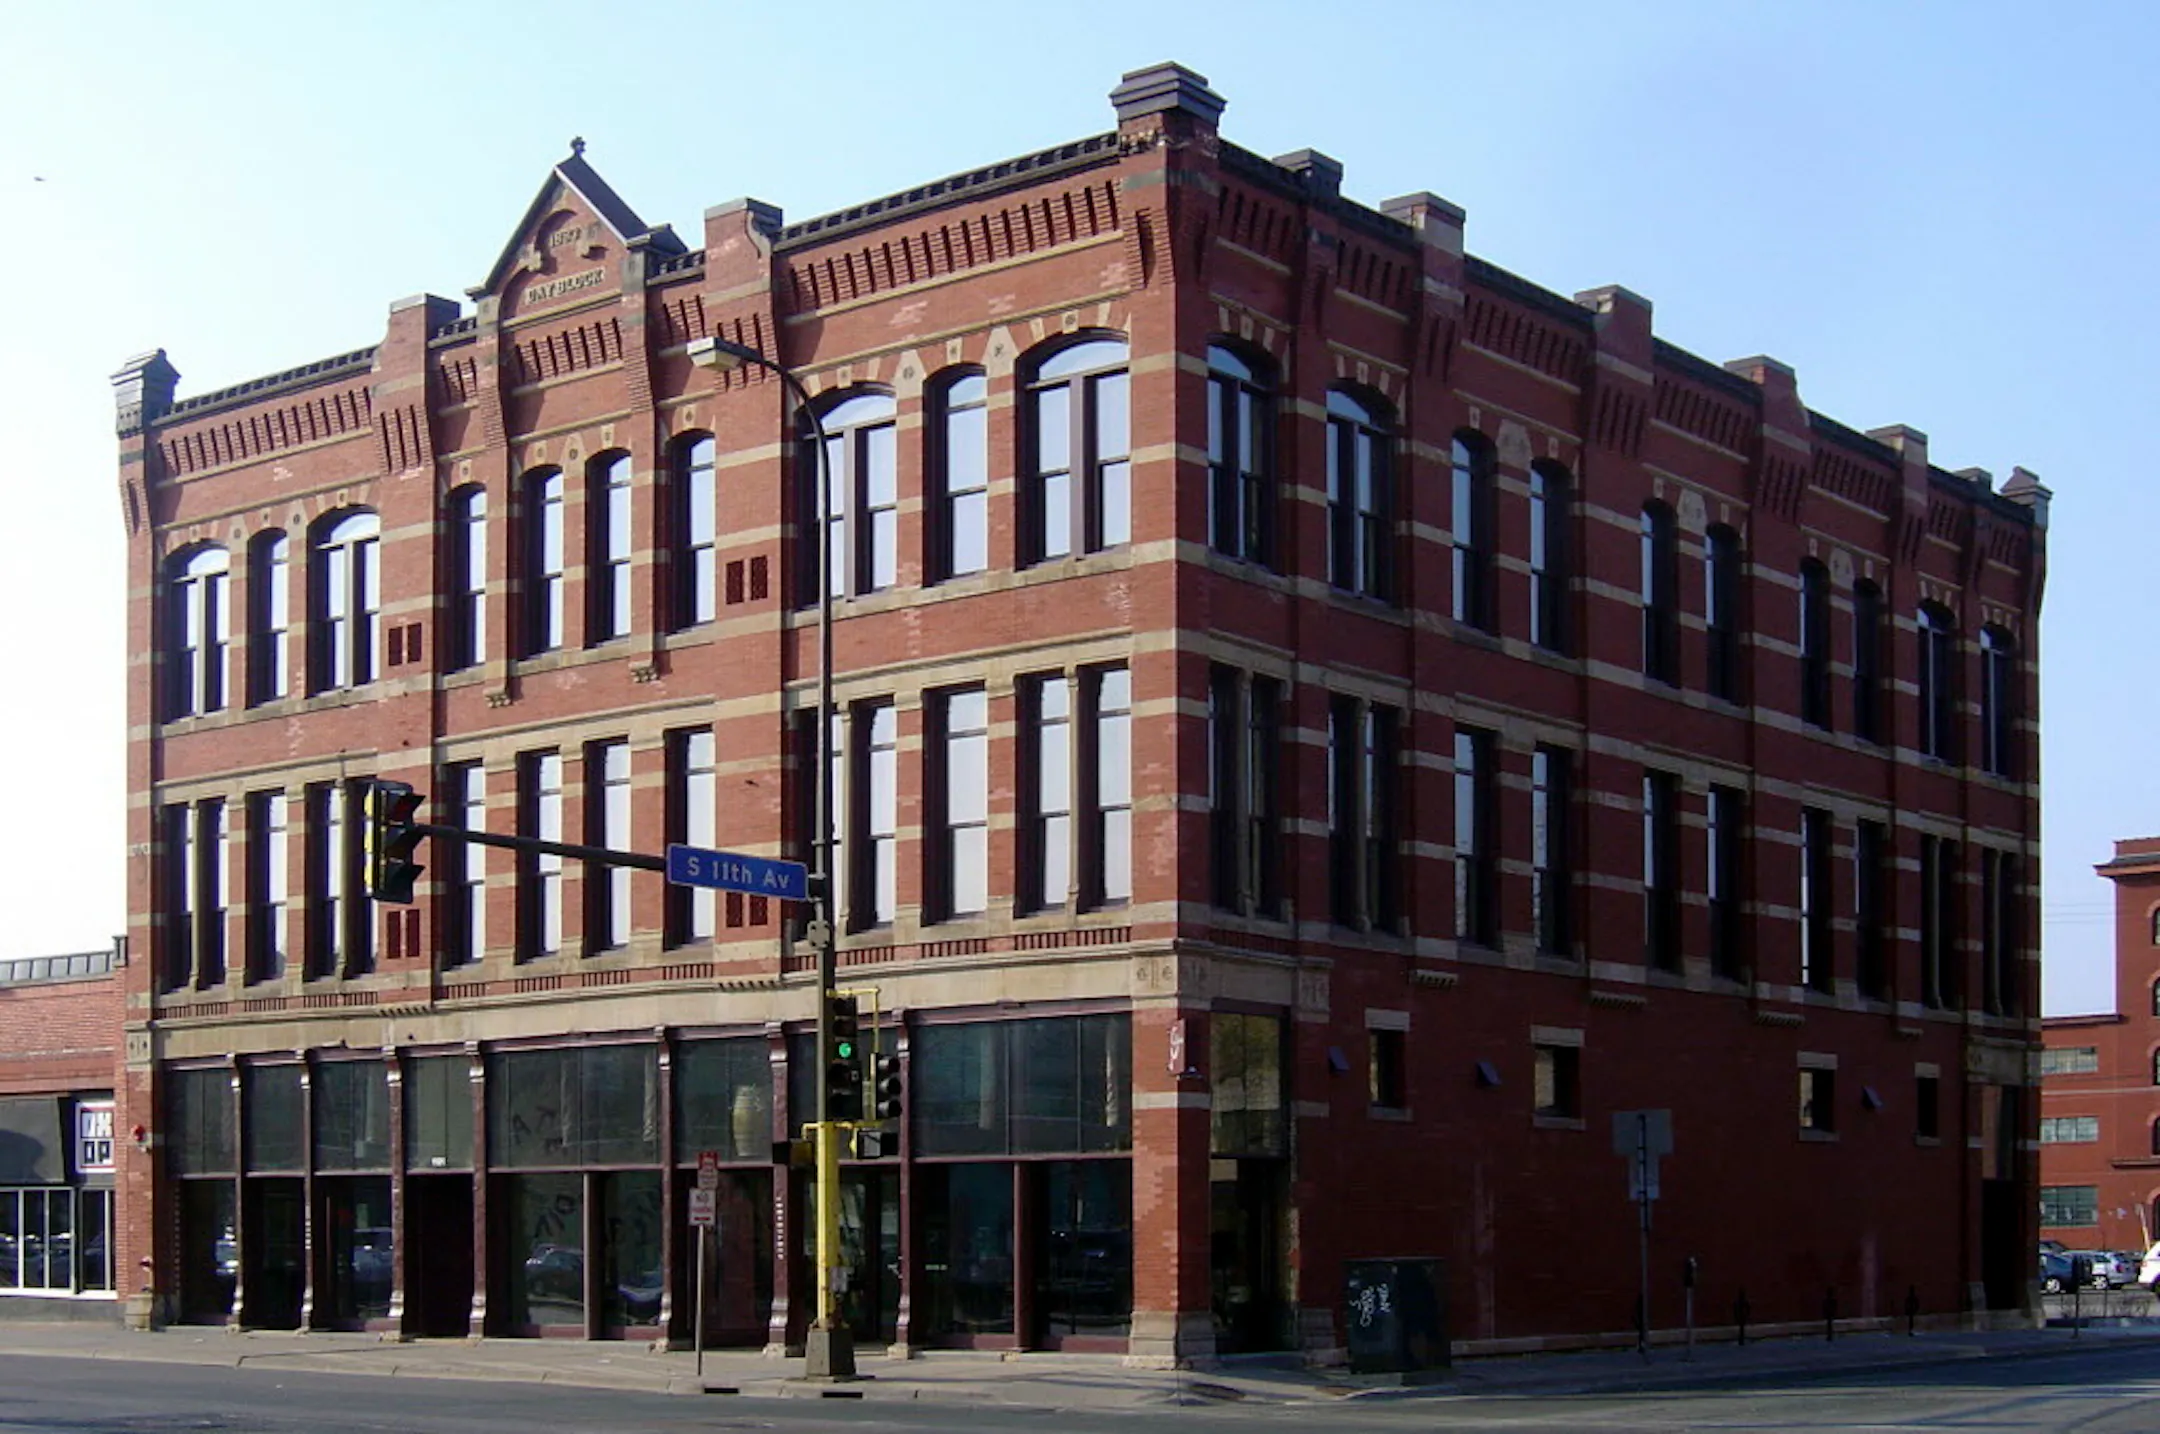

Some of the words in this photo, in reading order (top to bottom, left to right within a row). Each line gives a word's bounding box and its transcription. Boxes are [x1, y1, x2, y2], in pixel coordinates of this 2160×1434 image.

[558, 267, 604, 296] BLOCK
[687, 856, 700, 876] S
[711, 860, 753, 884] 11th
[763, 867, 790, 889] Av
